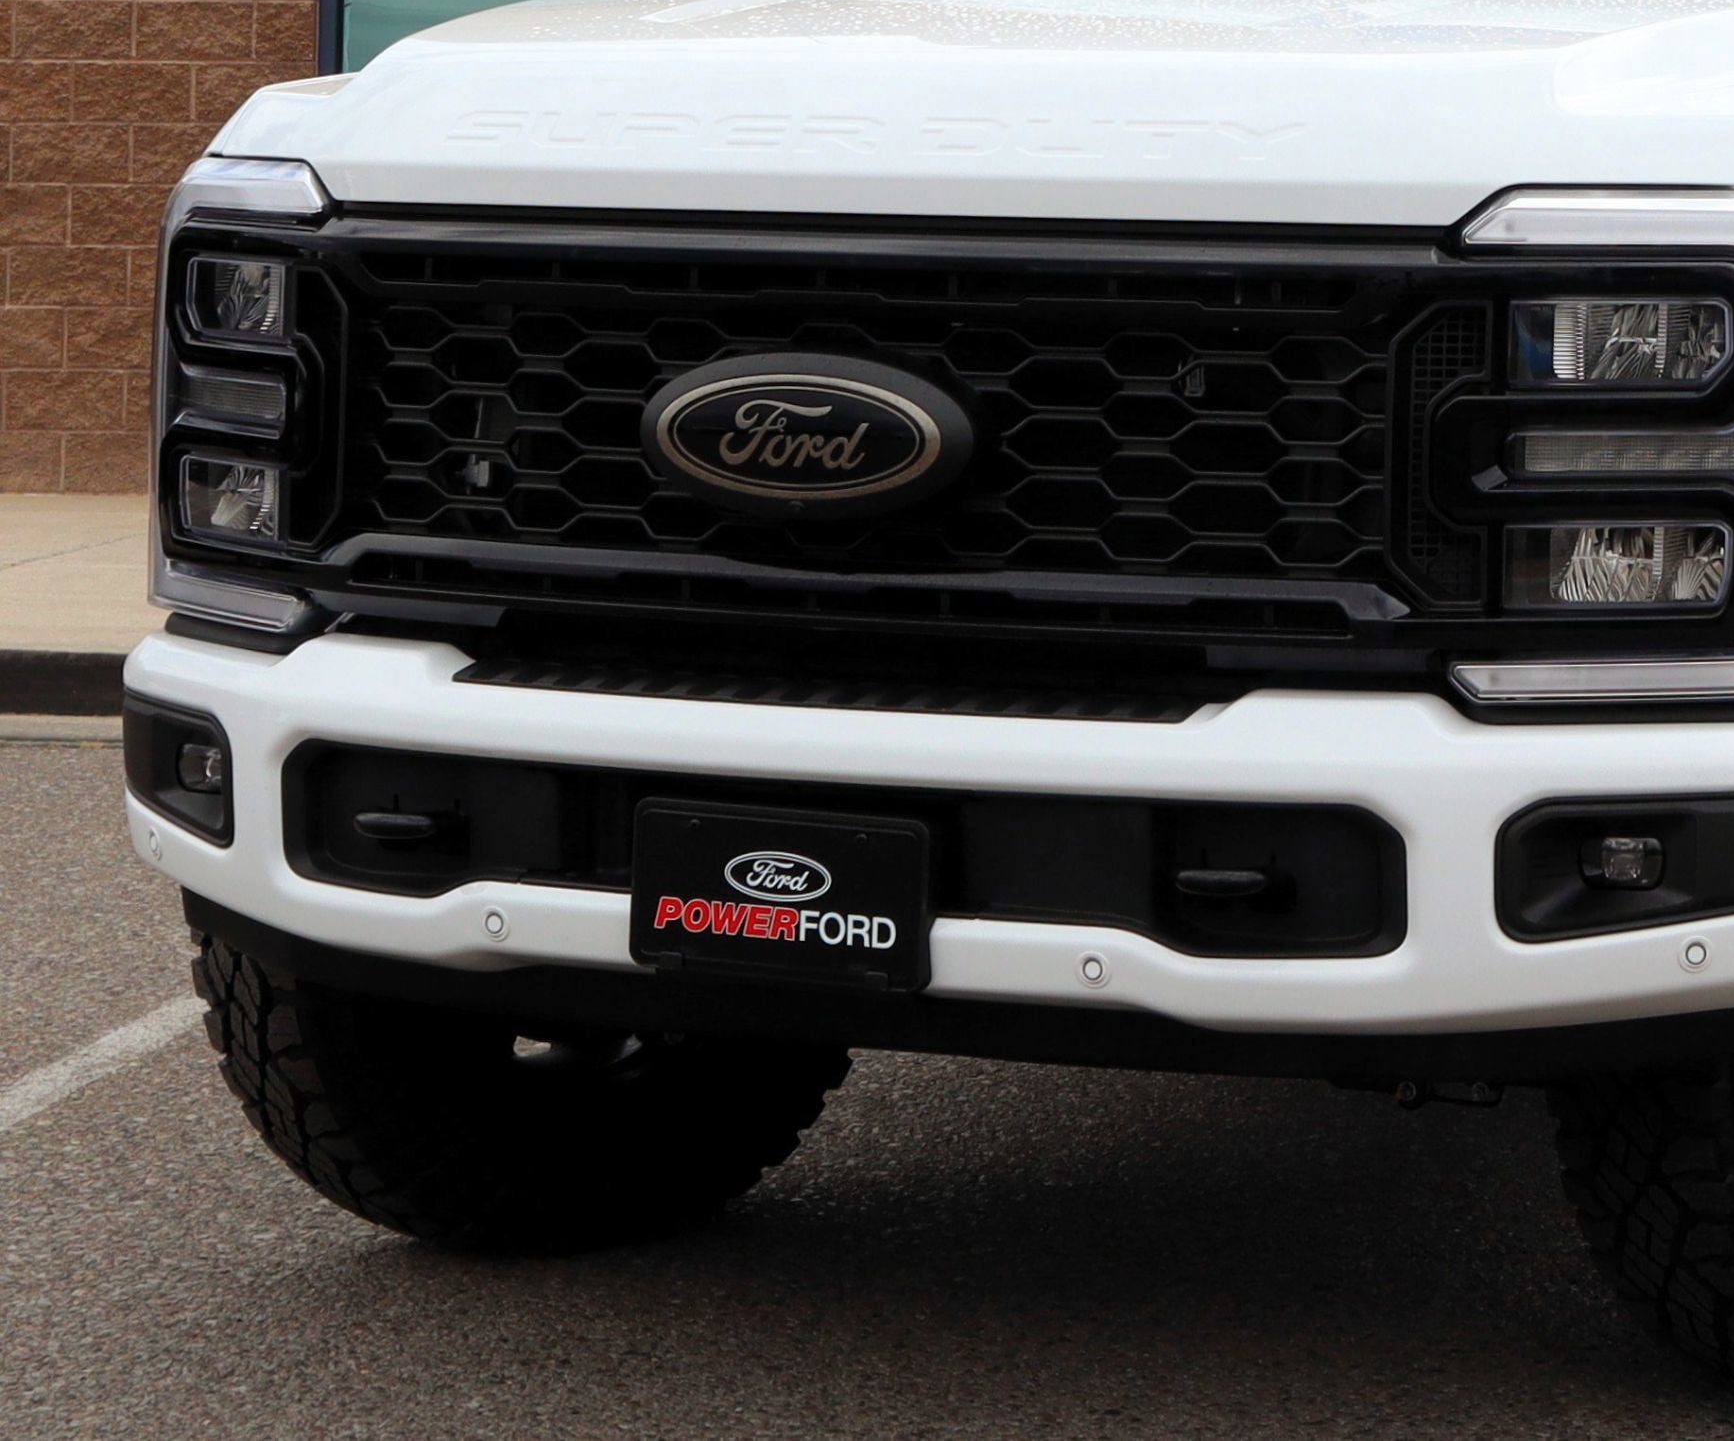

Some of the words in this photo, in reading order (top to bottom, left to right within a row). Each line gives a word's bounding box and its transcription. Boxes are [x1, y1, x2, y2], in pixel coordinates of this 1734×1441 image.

[719, 399, 869, 469] Ford
[746, 859, 809, 891] Ford
[654, 896, 896, 949] POWERFORD
